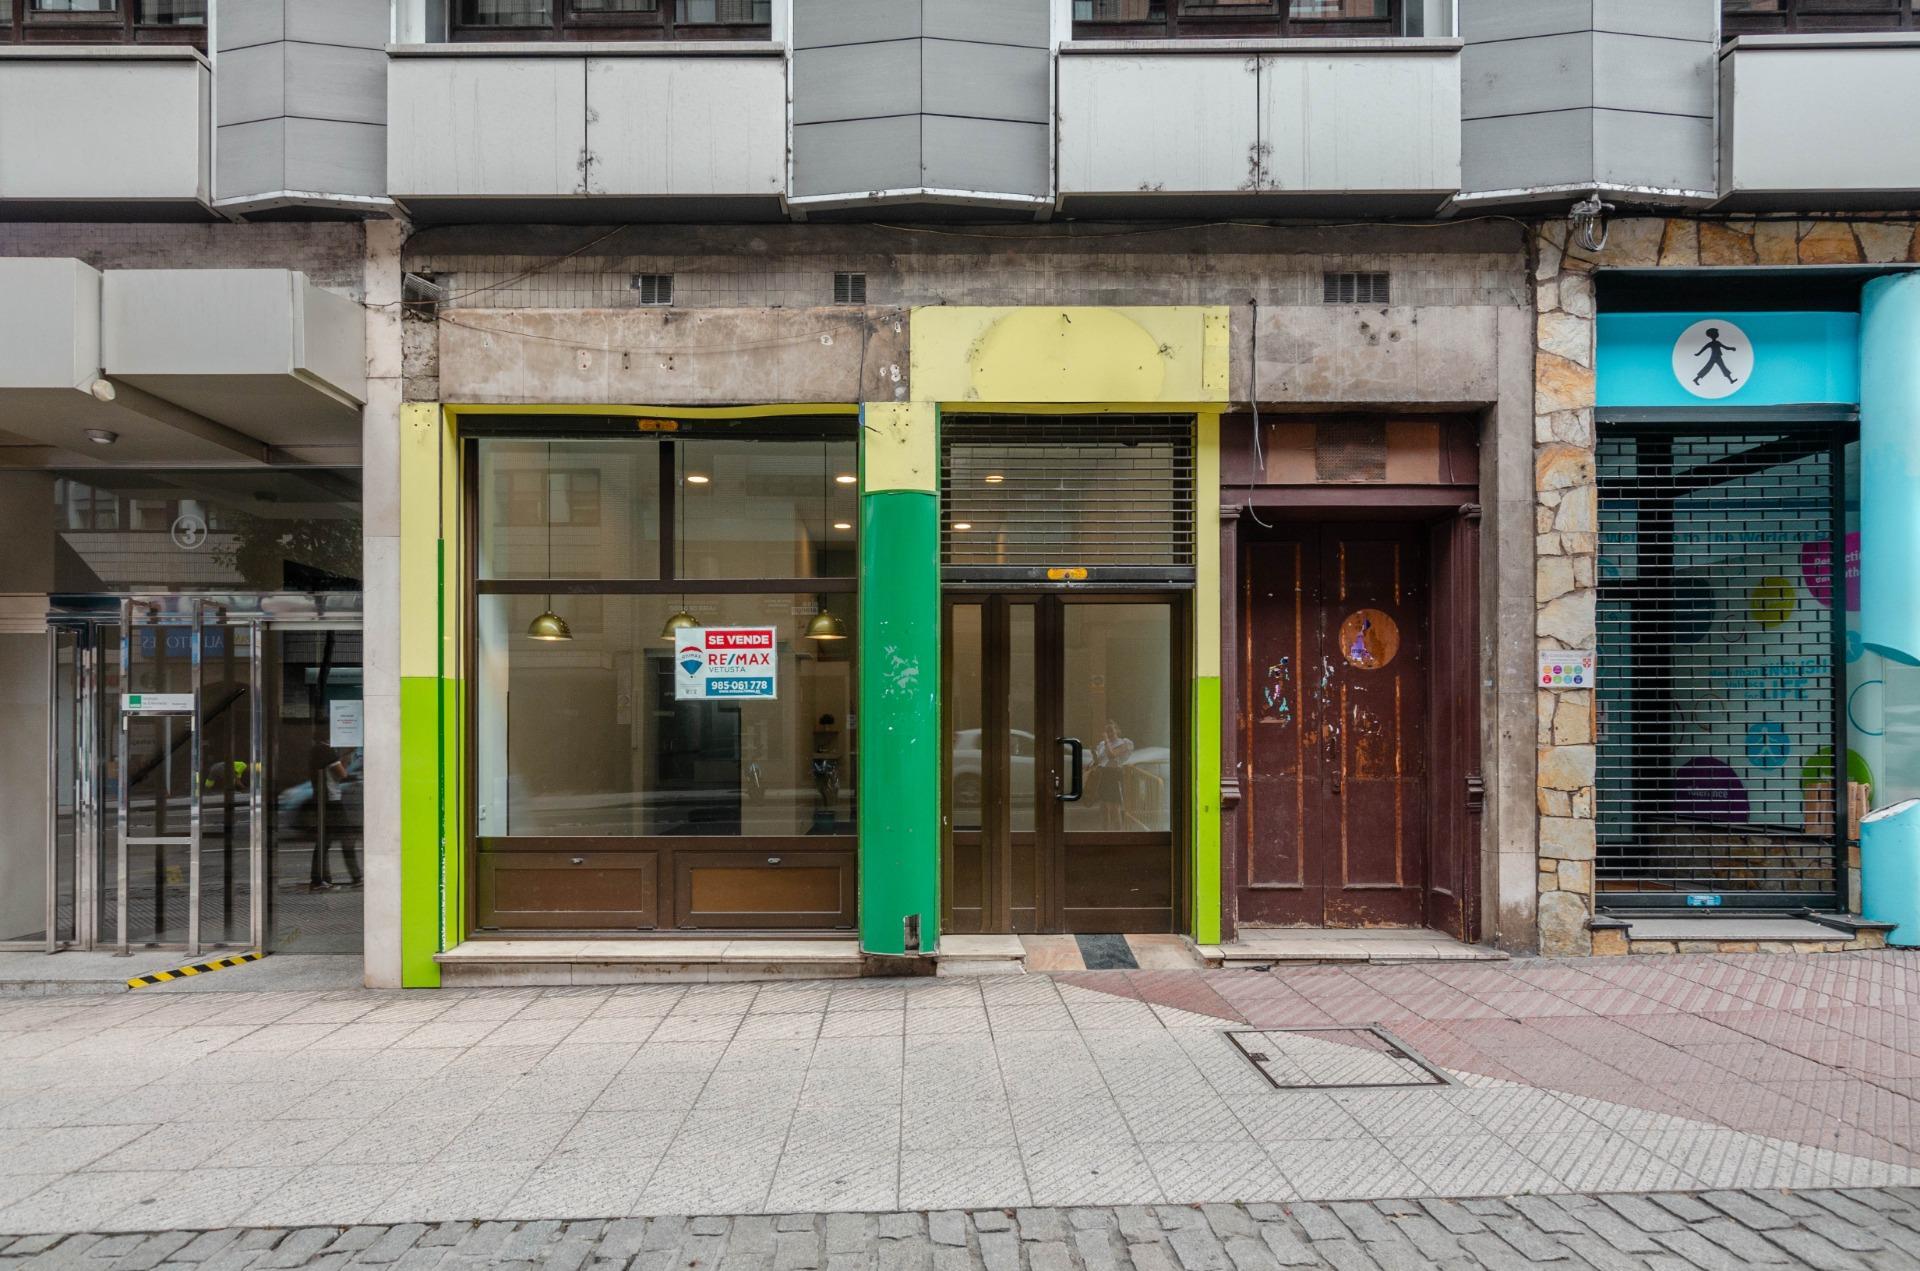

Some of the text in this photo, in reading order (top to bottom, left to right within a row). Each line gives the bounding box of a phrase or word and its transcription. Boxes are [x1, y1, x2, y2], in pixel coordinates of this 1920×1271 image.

[182, 520, 196, 544] 3
[708, 634, 769, 645] SE VENDE
[708, 653, 770, 666] RE/MAX
[711, 680, 768, 690] 985 061 778
